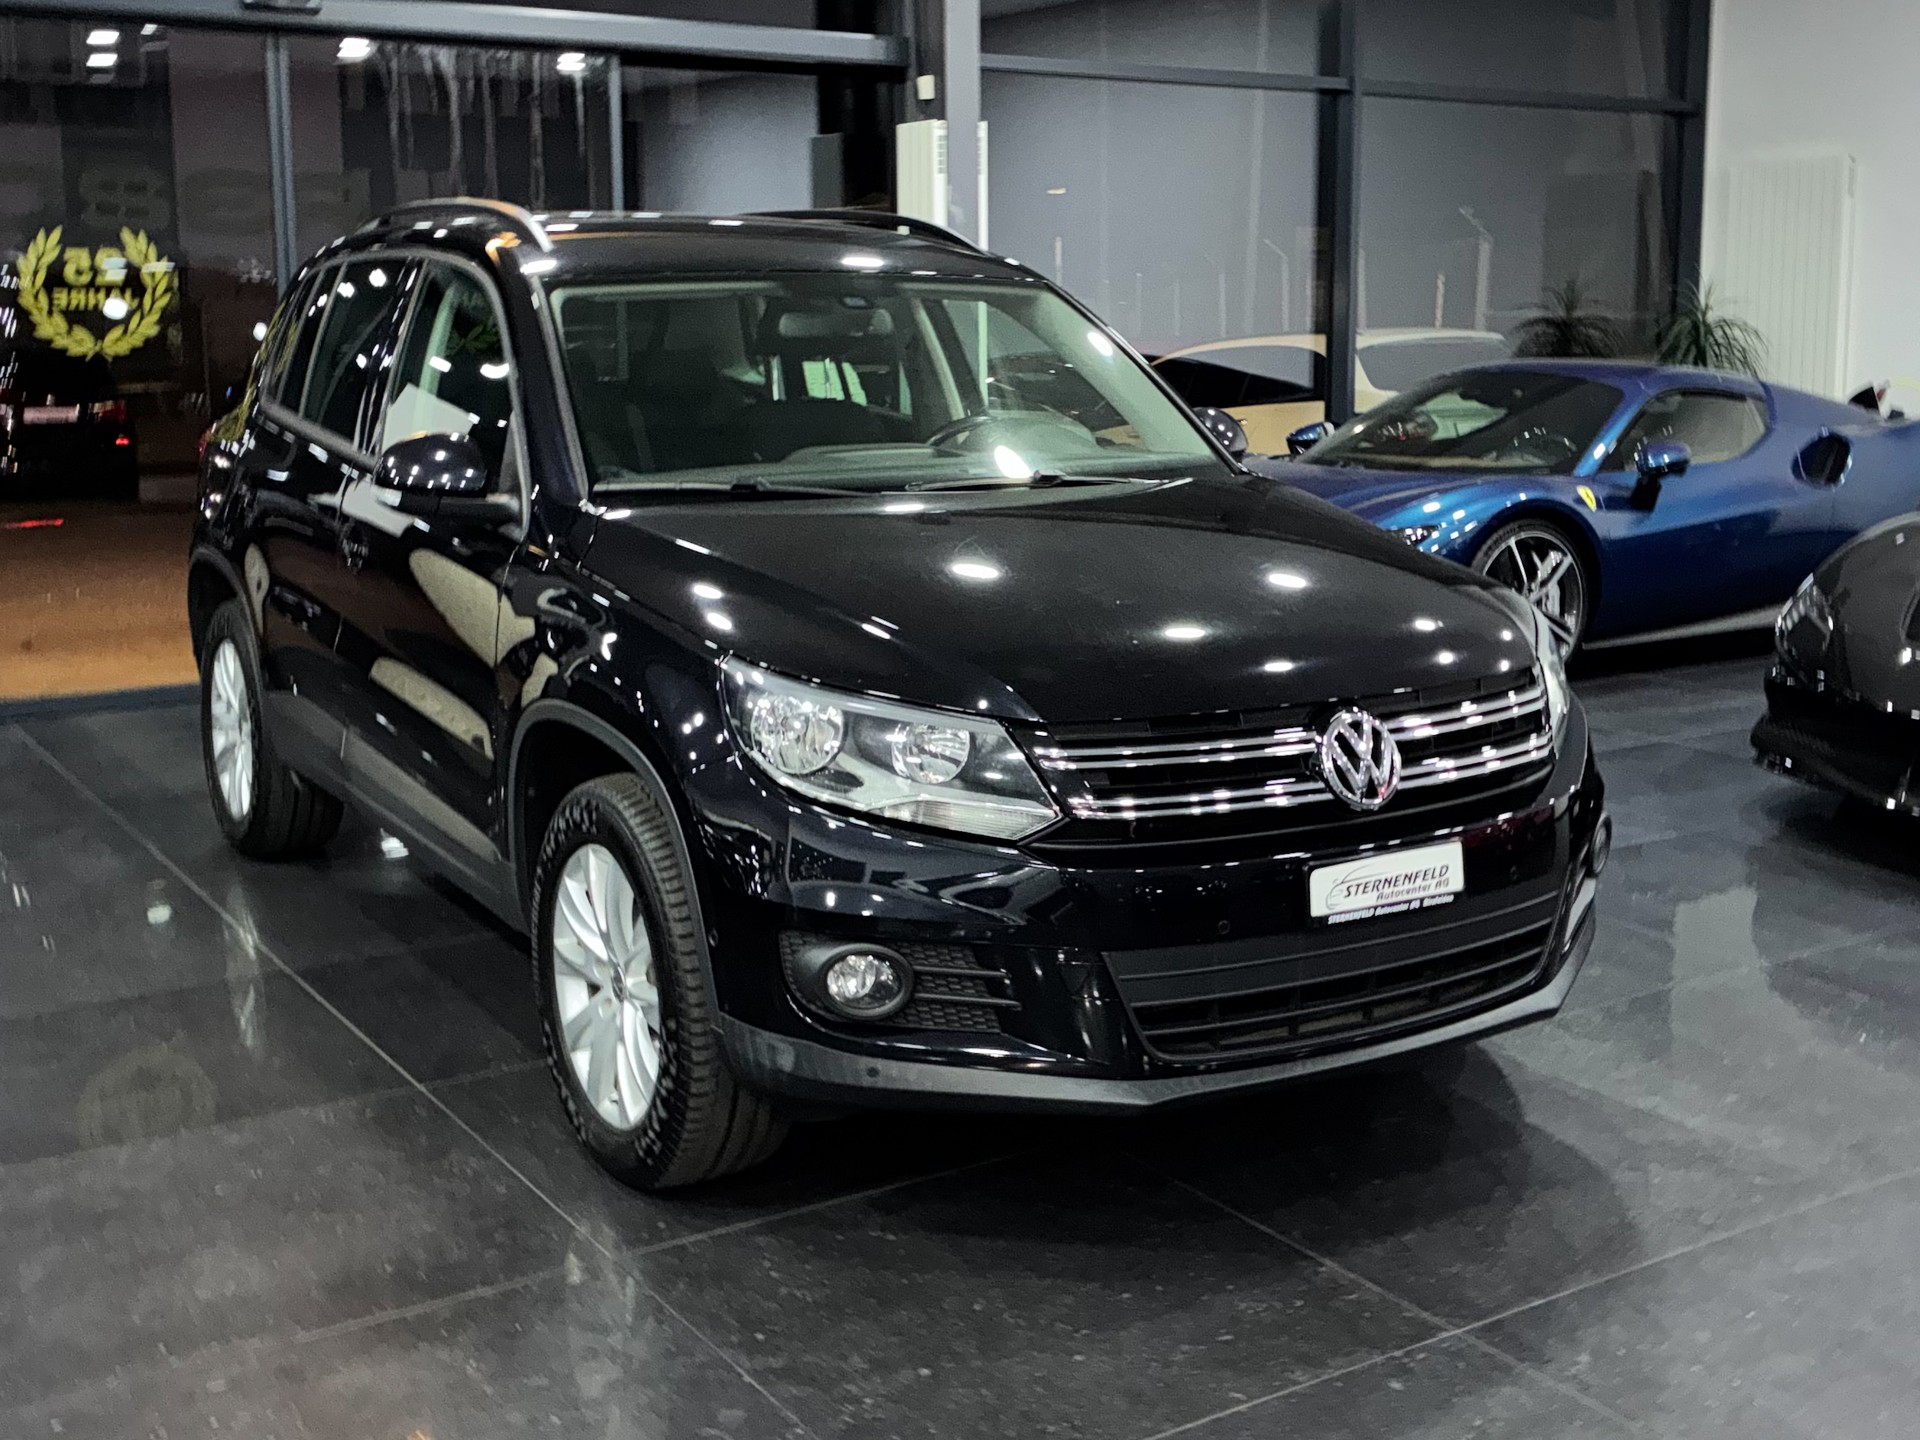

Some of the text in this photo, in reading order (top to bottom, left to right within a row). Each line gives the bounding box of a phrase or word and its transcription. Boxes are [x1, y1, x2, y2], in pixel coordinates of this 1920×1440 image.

[1325, 713, 1399, 803] VW
[1344, 864, 1450, 898] STERNENFELD
[1376, 882, 1432, 902] Autocenter
[1435, 877, 1450, 890] AG
